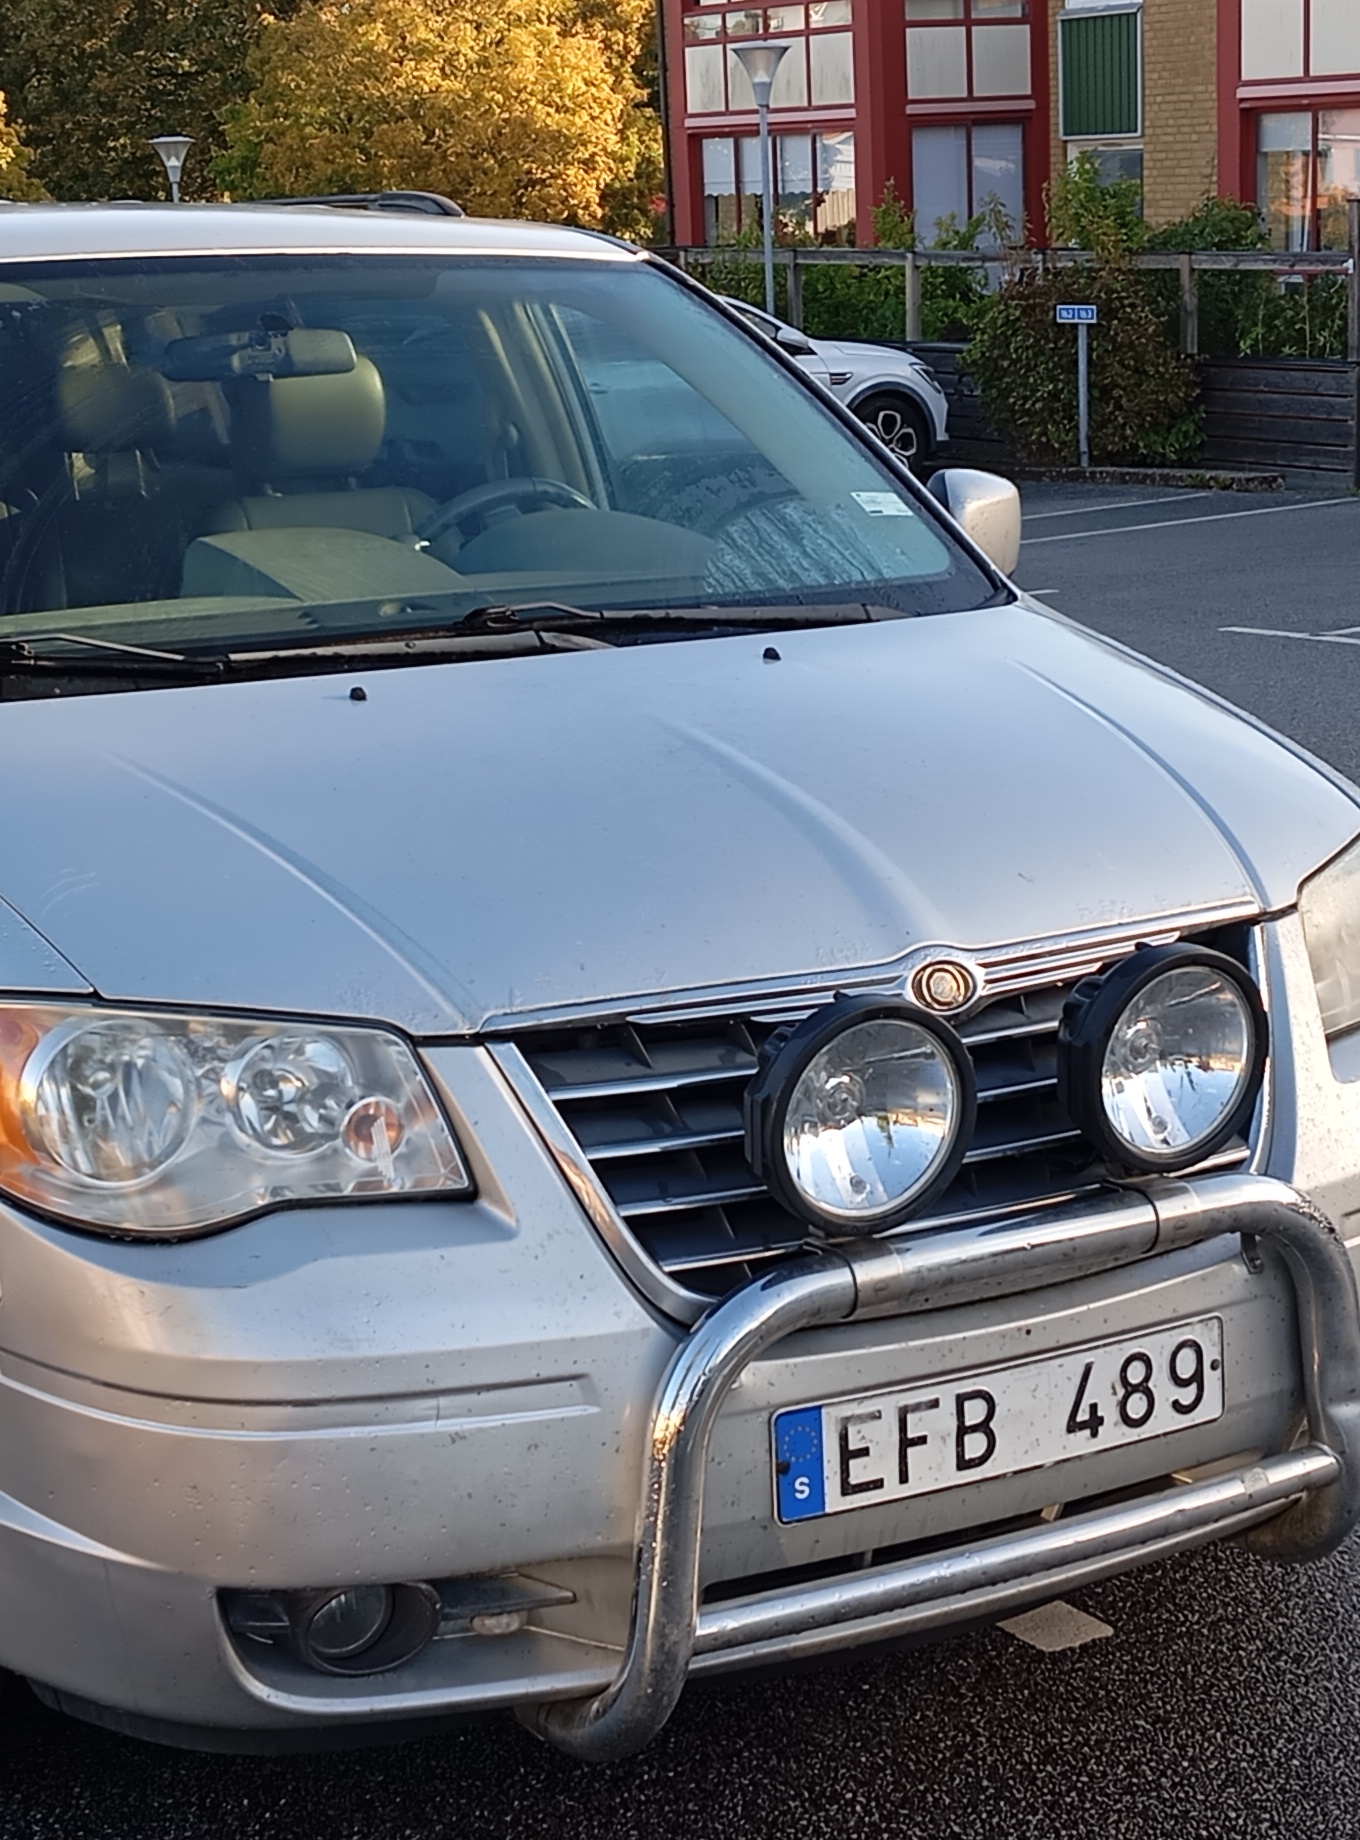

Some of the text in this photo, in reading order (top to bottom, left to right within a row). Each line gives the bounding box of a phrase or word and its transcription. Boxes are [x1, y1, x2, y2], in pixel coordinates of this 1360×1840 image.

[838, 1338, 1205, 1497] EFB 489
[794, 1476, 810, 1500] S
